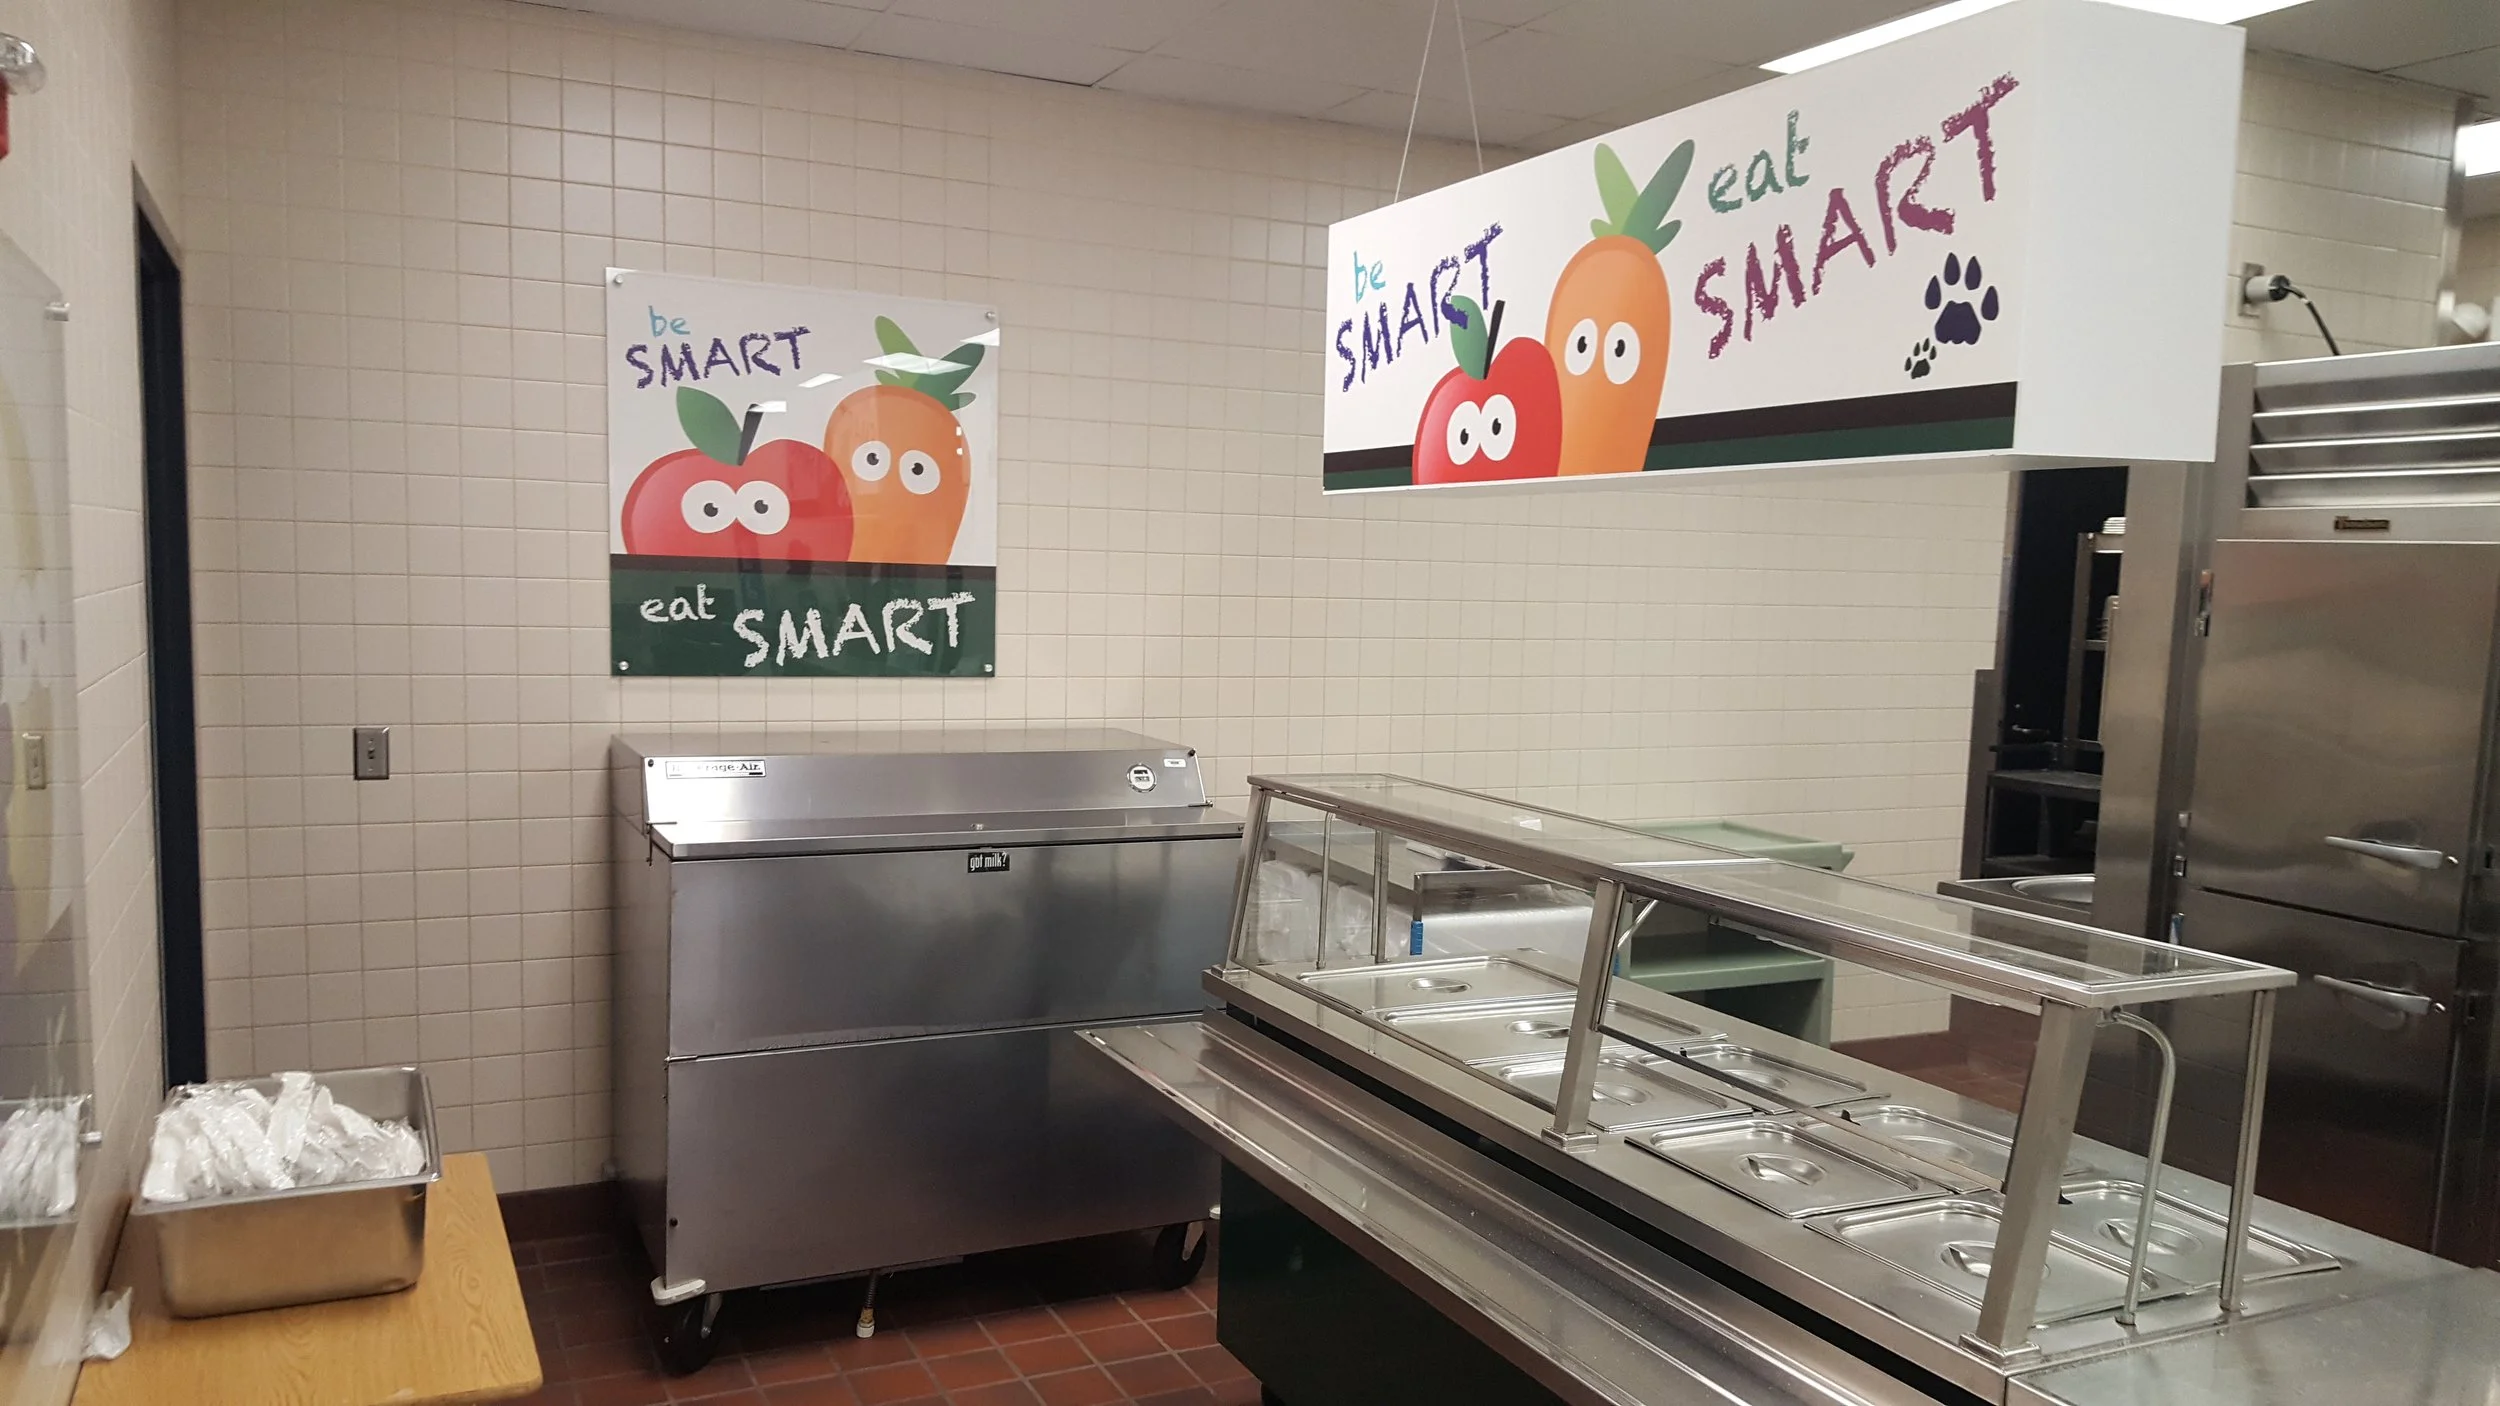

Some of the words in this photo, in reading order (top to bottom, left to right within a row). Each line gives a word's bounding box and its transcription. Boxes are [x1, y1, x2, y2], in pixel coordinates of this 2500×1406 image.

[1707, 110, 1811, 214] eat
[1694, 72, 2020, 360] SMART
[1335, 222, 1503, 392] SMART
[1353, 251, 1385, 303] be
[626, 326, 810, 389] SMART
[649, 306, 690, 336] be
[640, 583, 717, 623] eat
[732, 592, 976, 668] SMART
[970, 854, 983, 871] got
[985, 851, 1007, 868] milk?
